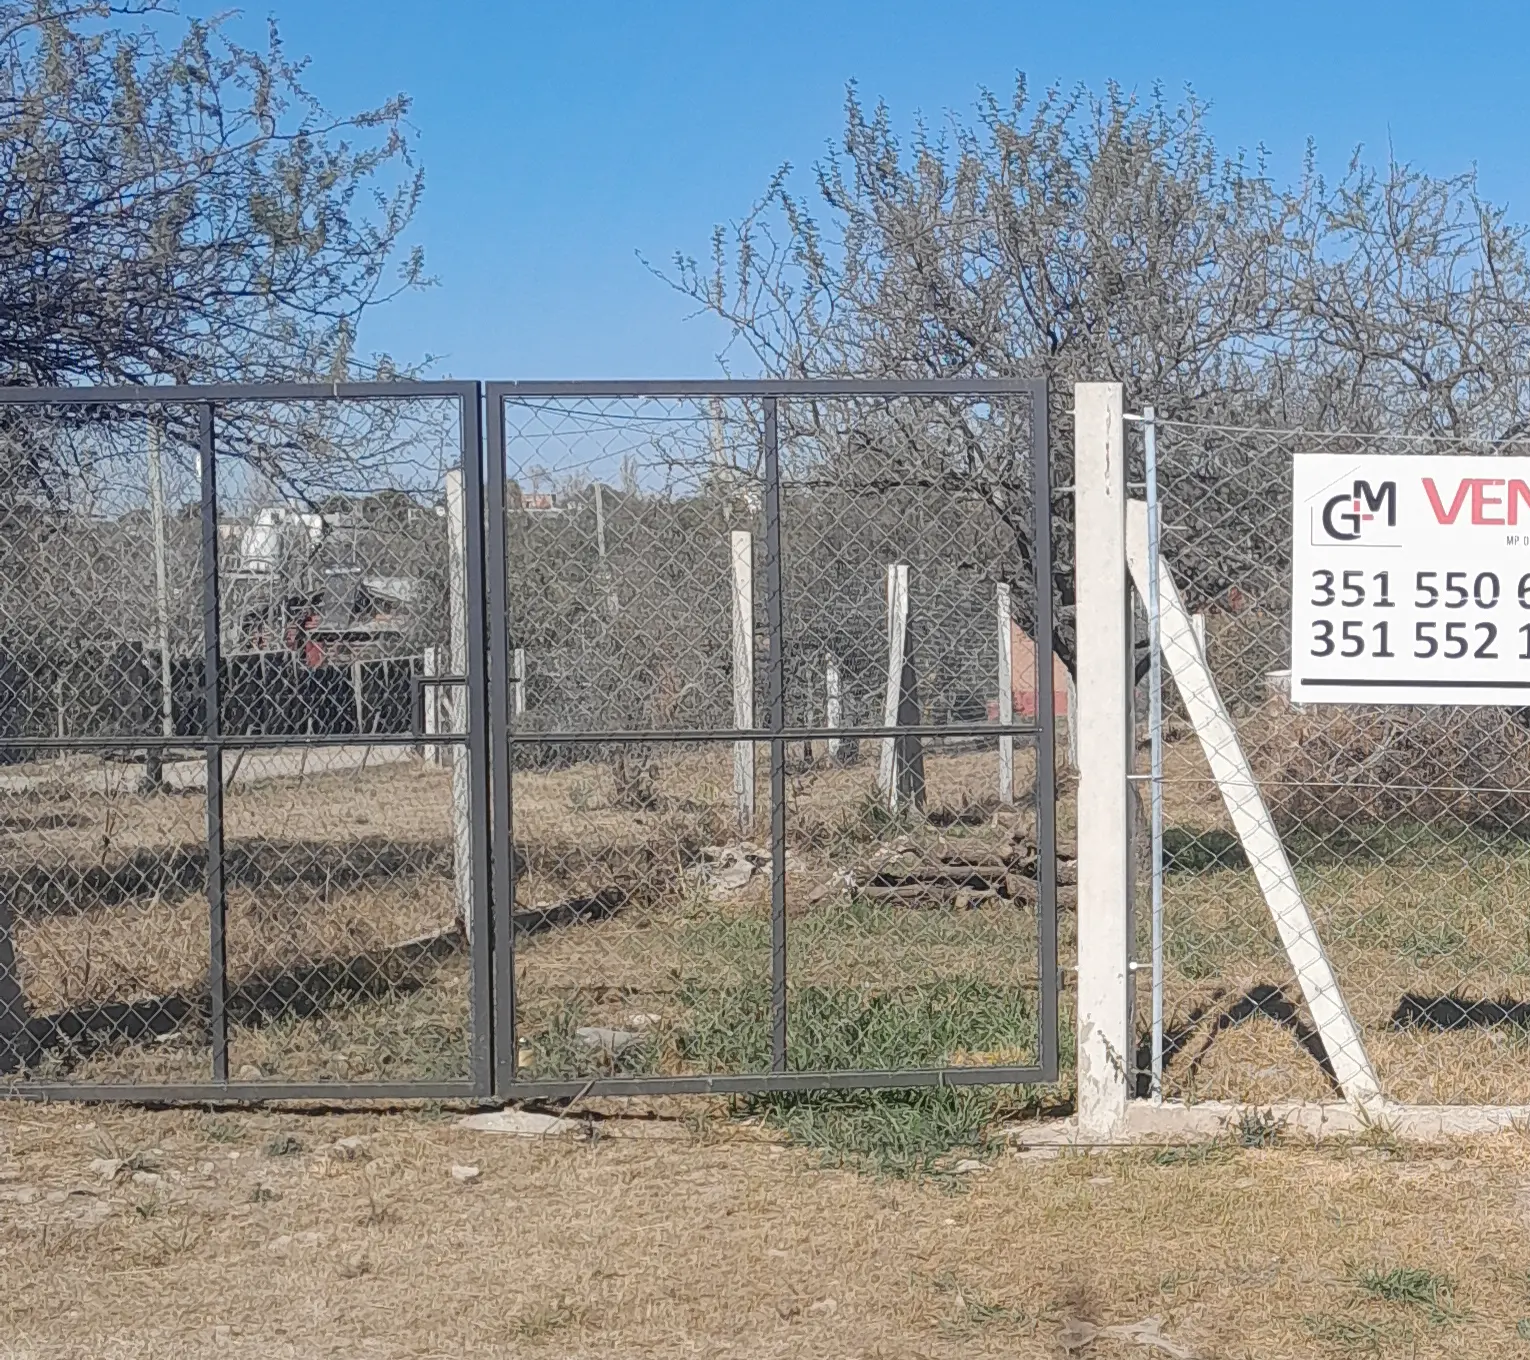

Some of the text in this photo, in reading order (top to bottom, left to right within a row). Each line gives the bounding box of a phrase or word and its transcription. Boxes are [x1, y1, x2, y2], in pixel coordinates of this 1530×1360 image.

[1322, 479, 1397, 541] GM
[1310, 569, 1396, 608] 351
[1414, 571, 1501, 610] 550
[1310, 619, 1395, 658] 351
[1413, 621, 1499, 659] 552
